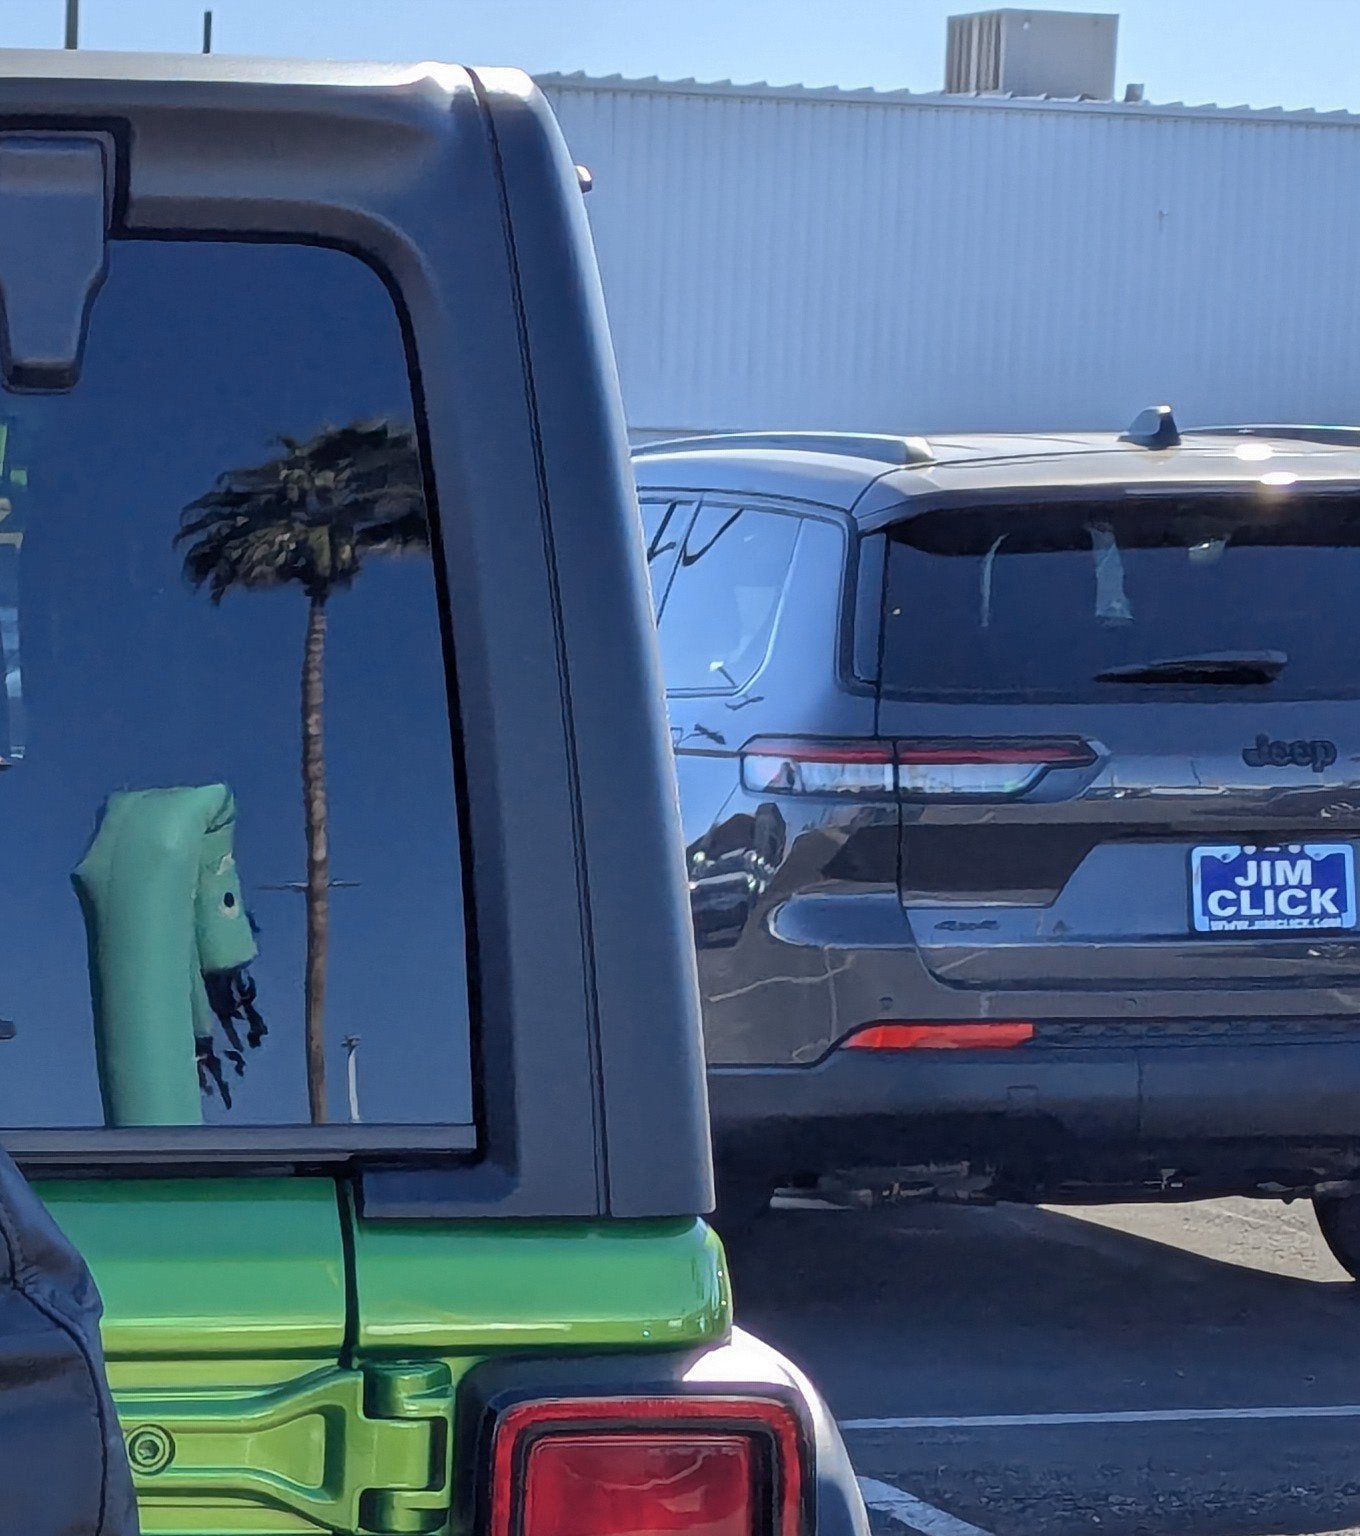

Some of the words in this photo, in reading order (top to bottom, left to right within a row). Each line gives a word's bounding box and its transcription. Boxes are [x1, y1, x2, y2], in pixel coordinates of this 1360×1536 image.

[1242, 734, 1337, 773] Jeep
[1234, 859, 1312, 887] JIM
[1207, 888, 1339, 917] CLICK
